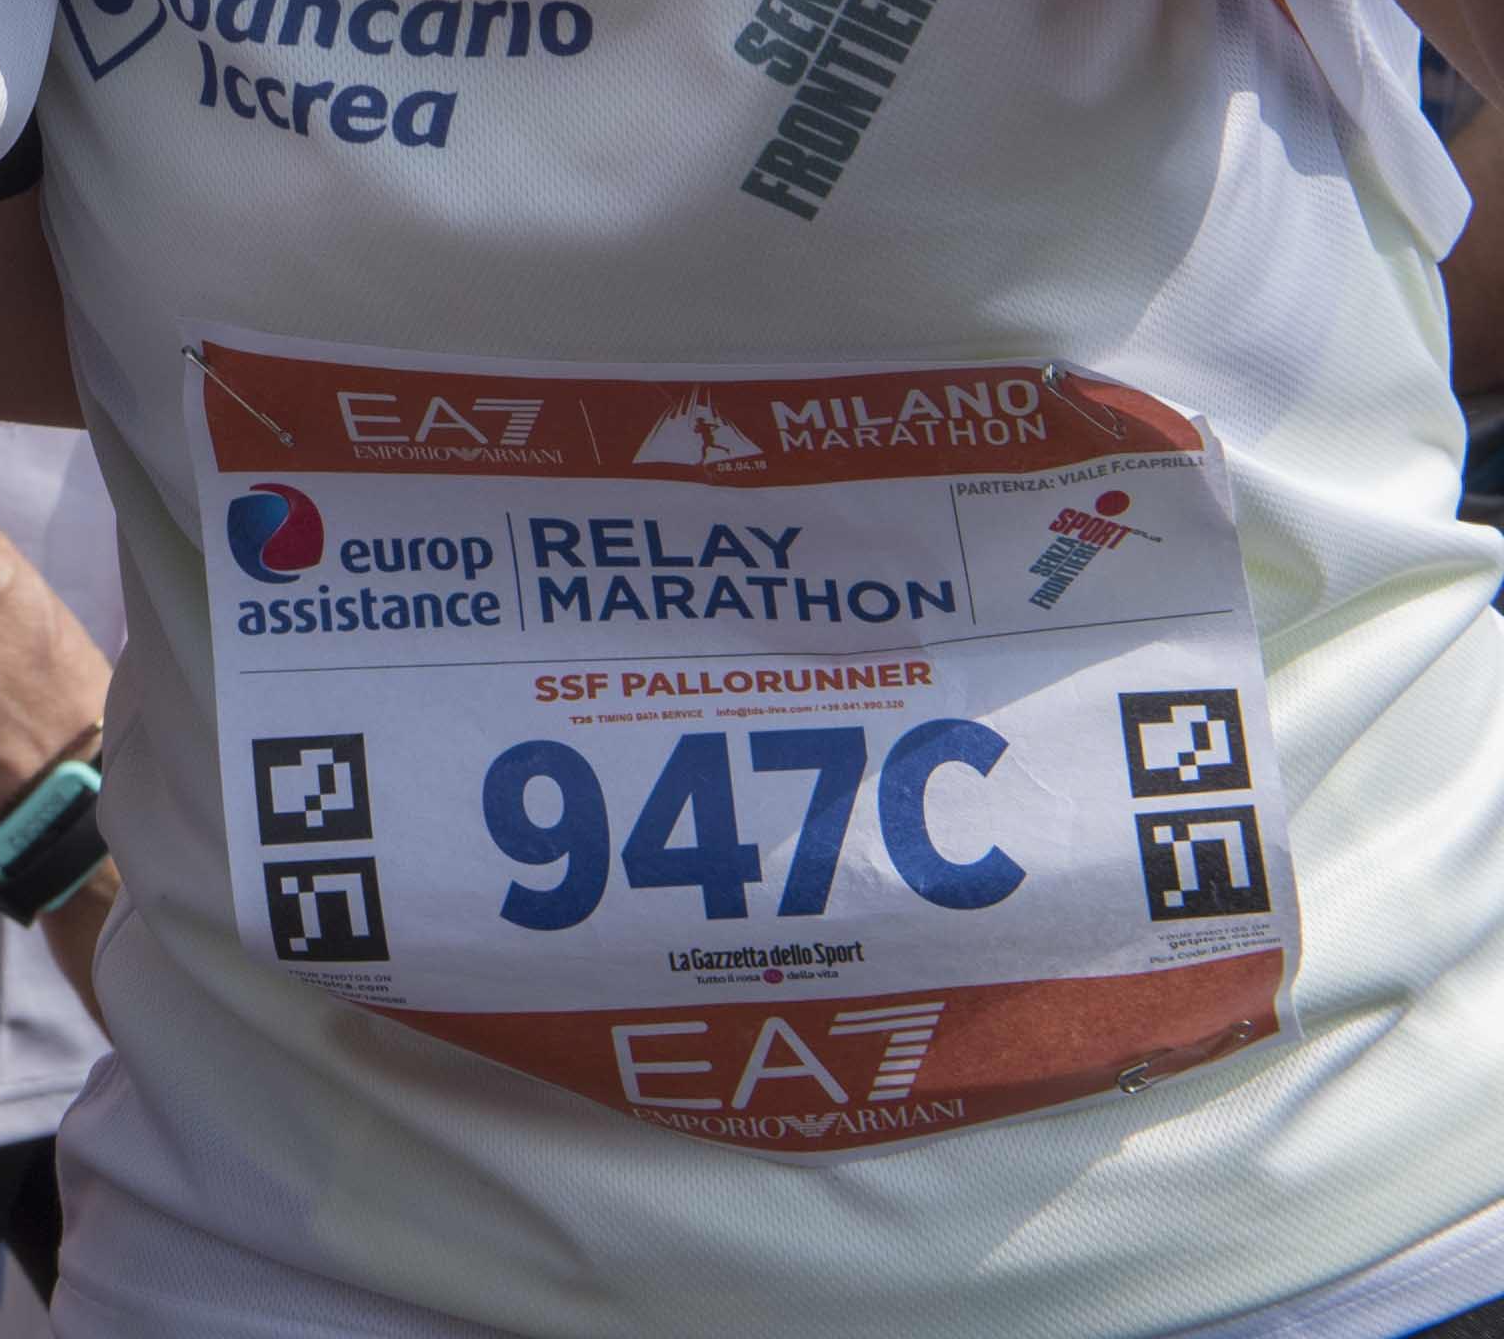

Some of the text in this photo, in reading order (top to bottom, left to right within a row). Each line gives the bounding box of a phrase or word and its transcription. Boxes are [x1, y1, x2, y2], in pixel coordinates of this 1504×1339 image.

[198, 41, 457, 149] Iccrea
[336, 391, 544, 446] EA7
[770, 378, 1038, 431] MILANO
[353, 444, 563, 465] EMPORIO ARMANI
[779, 413, 1047, 453] MARATHON
[957, 464, 1108, 497] PARTENZA: VIALE
[529, 518, 802, 569] RELAY
[1048, 507, 1131, 549] SPORT
[340, 534, 493, 580] europ
[1029, 536, 1081, 577] SENZA
[238, 585, 500, 636] assistance
[539, 575, 956, 623] MARATHON
[535, 661, 933, 702] SSF PALLORUNNER
[482, 718, 1027, 932] 947C
[691, 947, 768, 971] Gazzetta
[769, 943, 813, 967] dello
[814, 940, 864, 968] Sport
[611, 1000, 946, 1110] EA7
[633, 1098, 964, 1141] EMPORIO ARMANI
